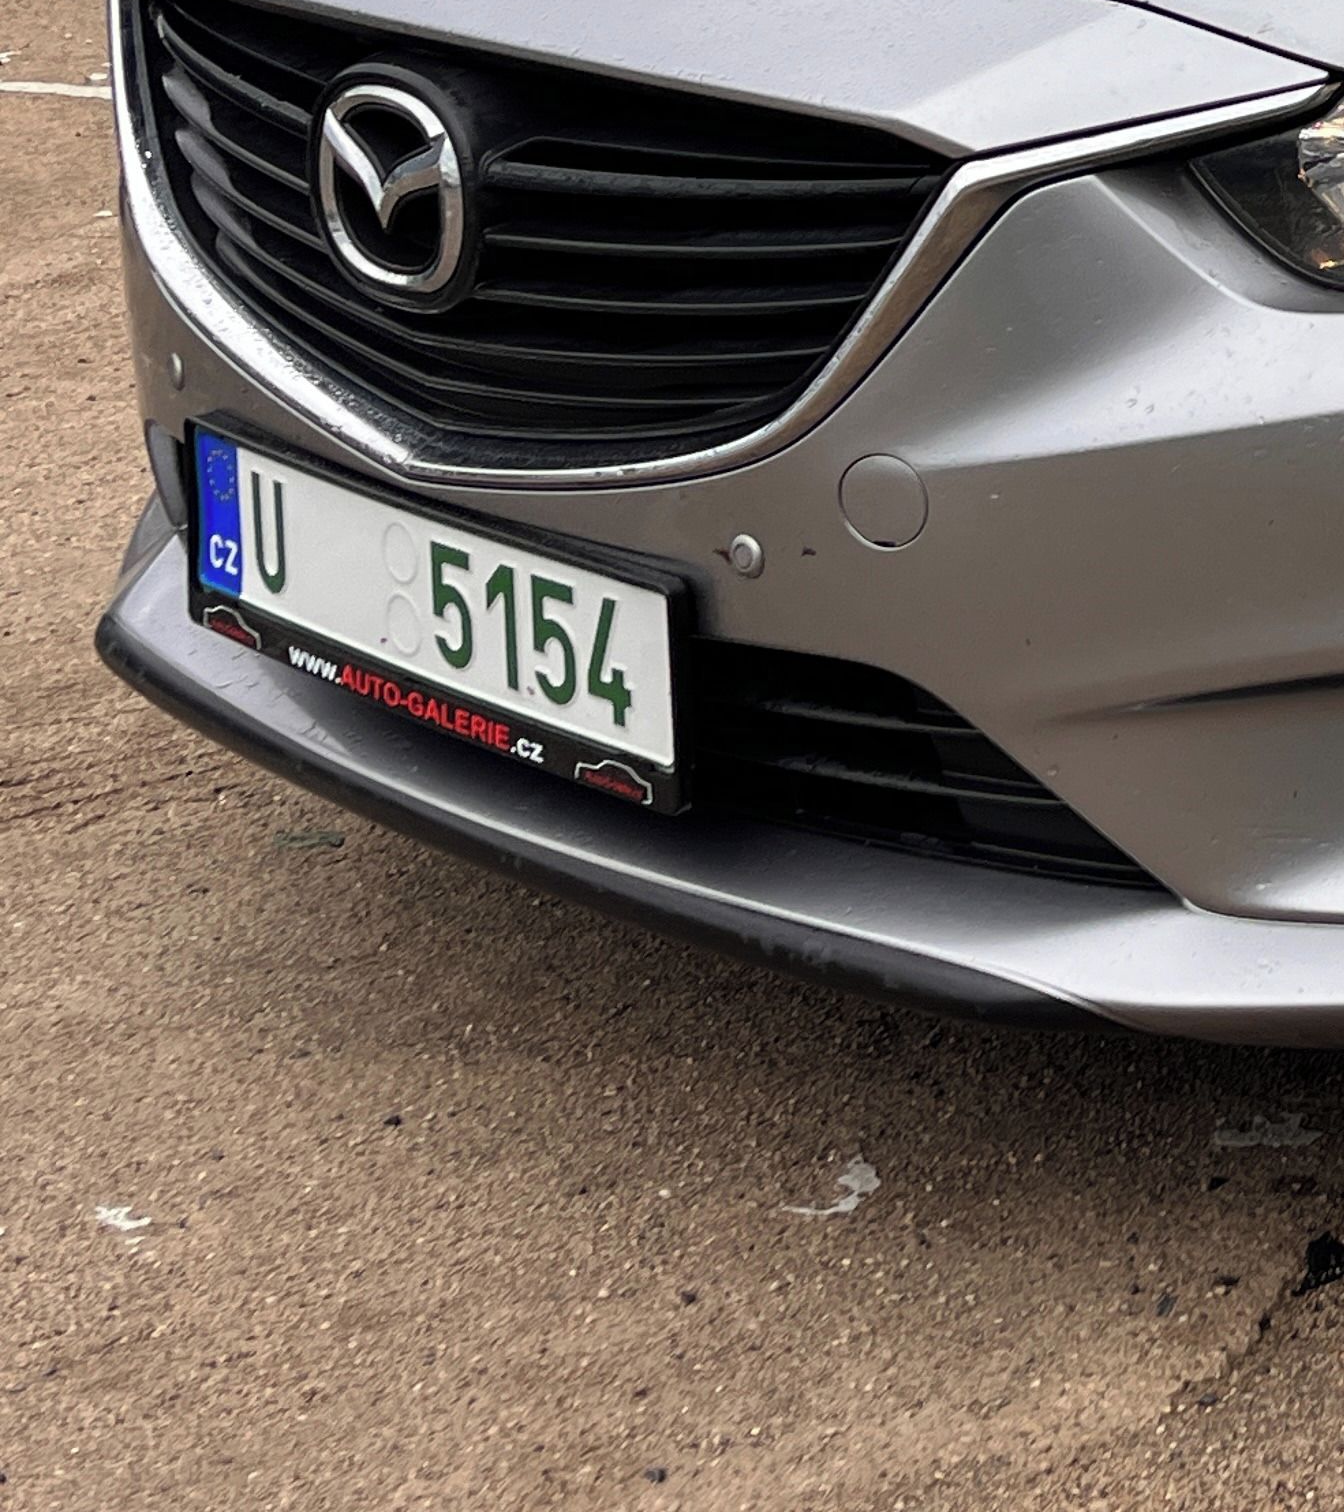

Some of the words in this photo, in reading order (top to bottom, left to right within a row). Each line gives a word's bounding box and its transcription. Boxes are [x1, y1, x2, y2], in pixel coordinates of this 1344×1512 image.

[208, 534, 239, 576] CZ
[250, 470, 287, 594] U
[429, 540, 632, 727] 5154
[287, 644, 545, 764] www.AUTO-GALERIE.cz
